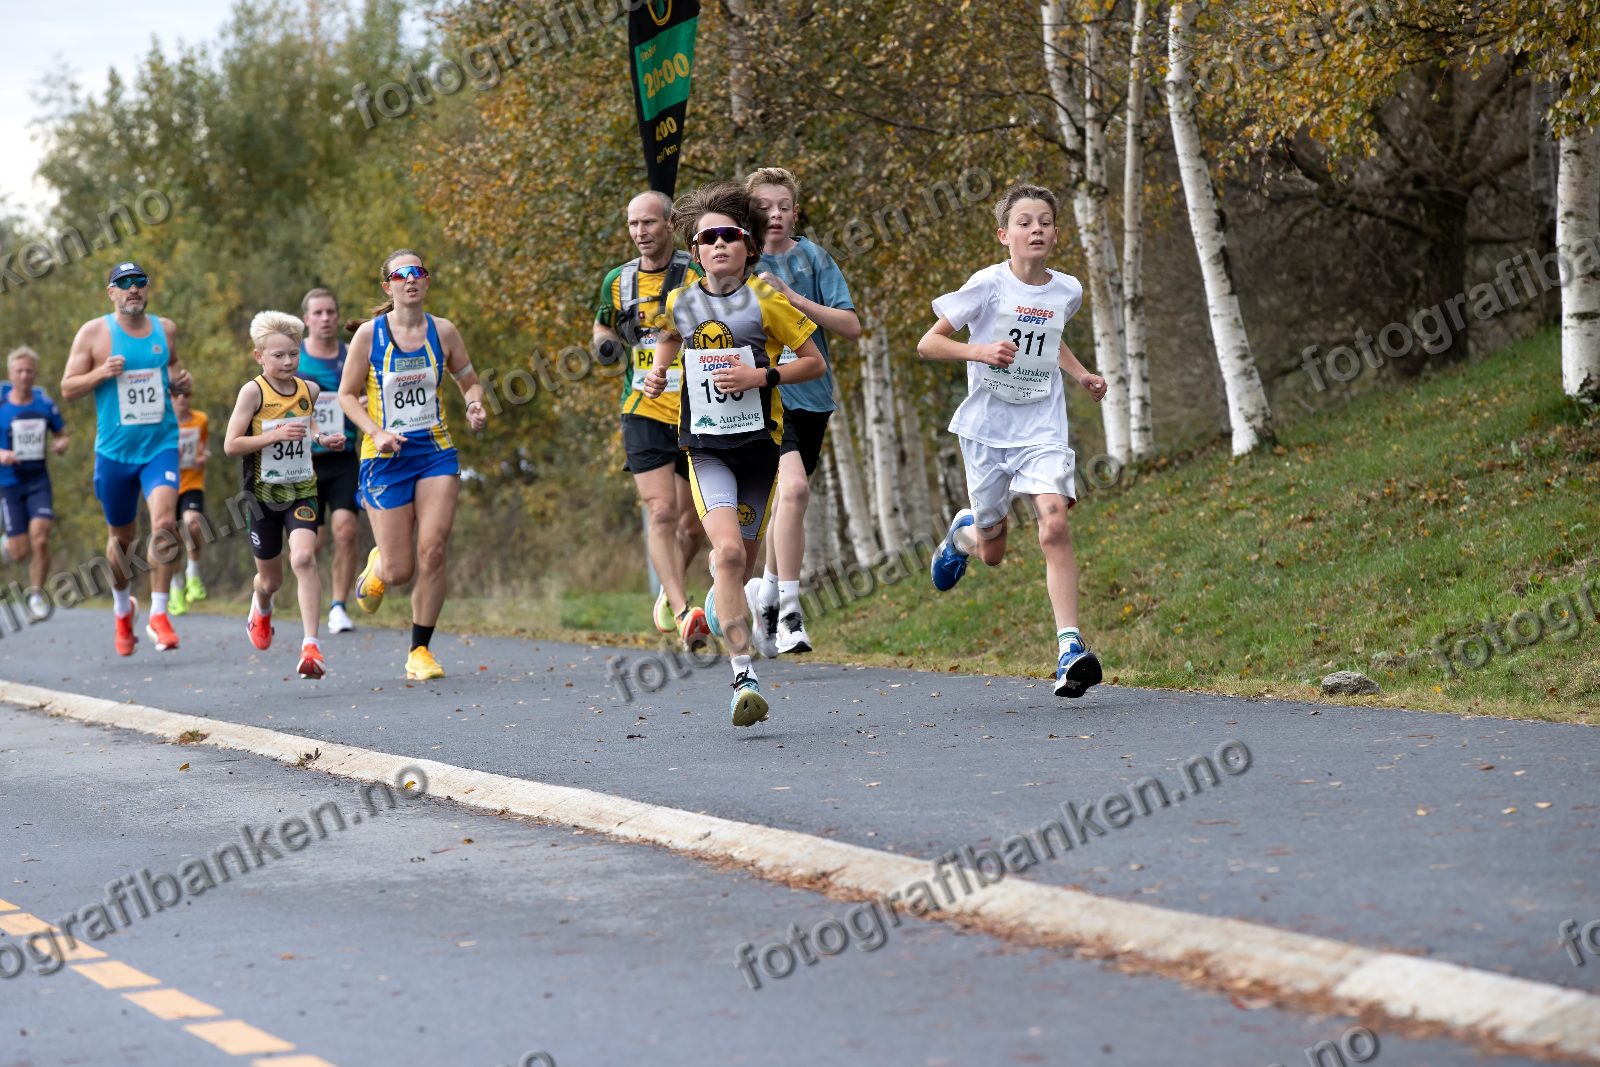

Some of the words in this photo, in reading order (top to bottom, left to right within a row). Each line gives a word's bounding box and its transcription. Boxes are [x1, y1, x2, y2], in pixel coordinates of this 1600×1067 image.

[644, 52, 690, 99] 20:00
[1015, 306, 1054, 318] NORGES
[1017, 314, 1047, 325] LØPET
[1009, 328, 1046, 356] 311
[395, 373, 427, 383] NORGES
[1014, 366, 1050, 381] Aurskog
[127, 387, 156, 405] 912
[394, 387, 427, 409] 840
[719, 411, 761, 424] Aurskog
[273, 439, 304, 461] 344
